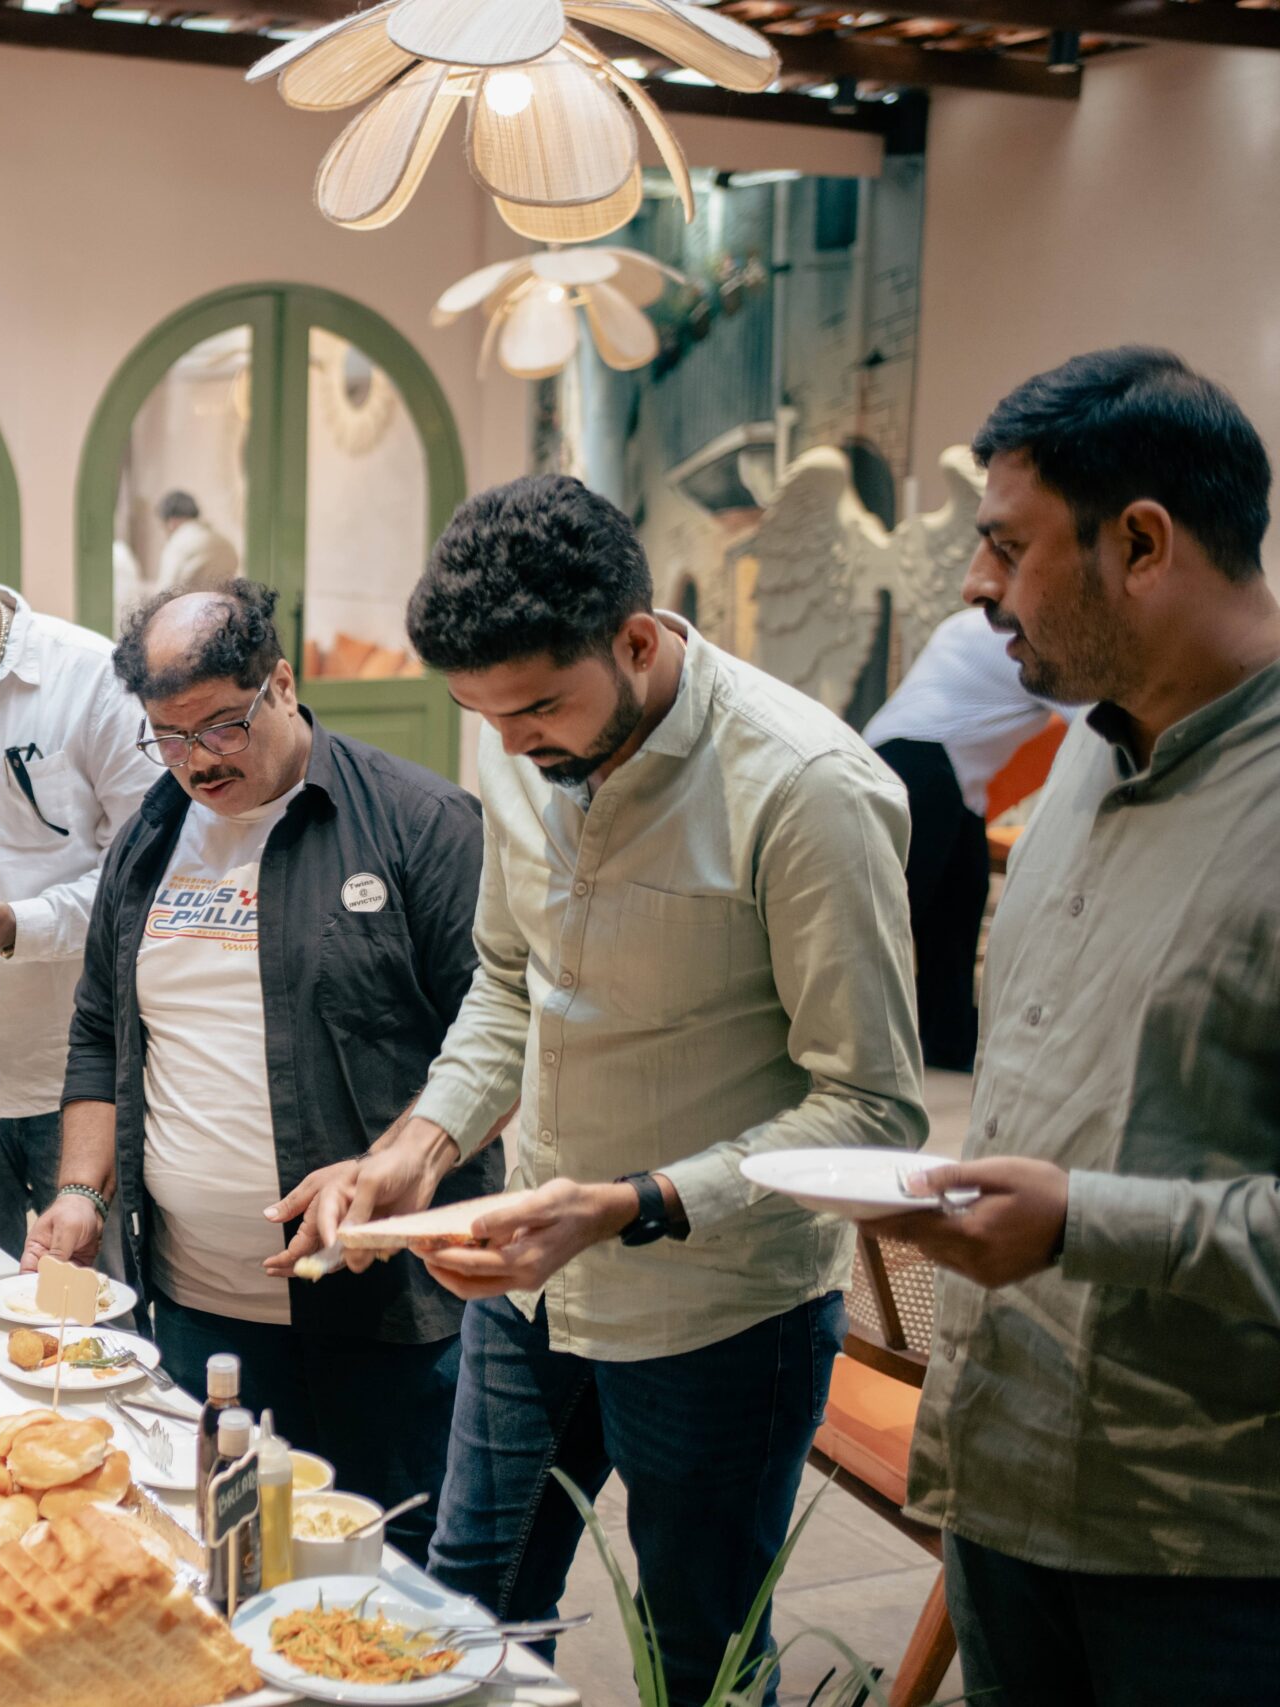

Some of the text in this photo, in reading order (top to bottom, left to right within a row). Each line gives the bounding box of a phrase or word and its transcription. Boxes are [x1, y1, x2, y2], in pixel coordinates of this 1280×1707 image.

[348, 880, 374, 889] Twins
[155, 888, 237, 907] LOUIS
[358, 888, 368, 898] @
[349, 895, 382, 907] INVICTUS
